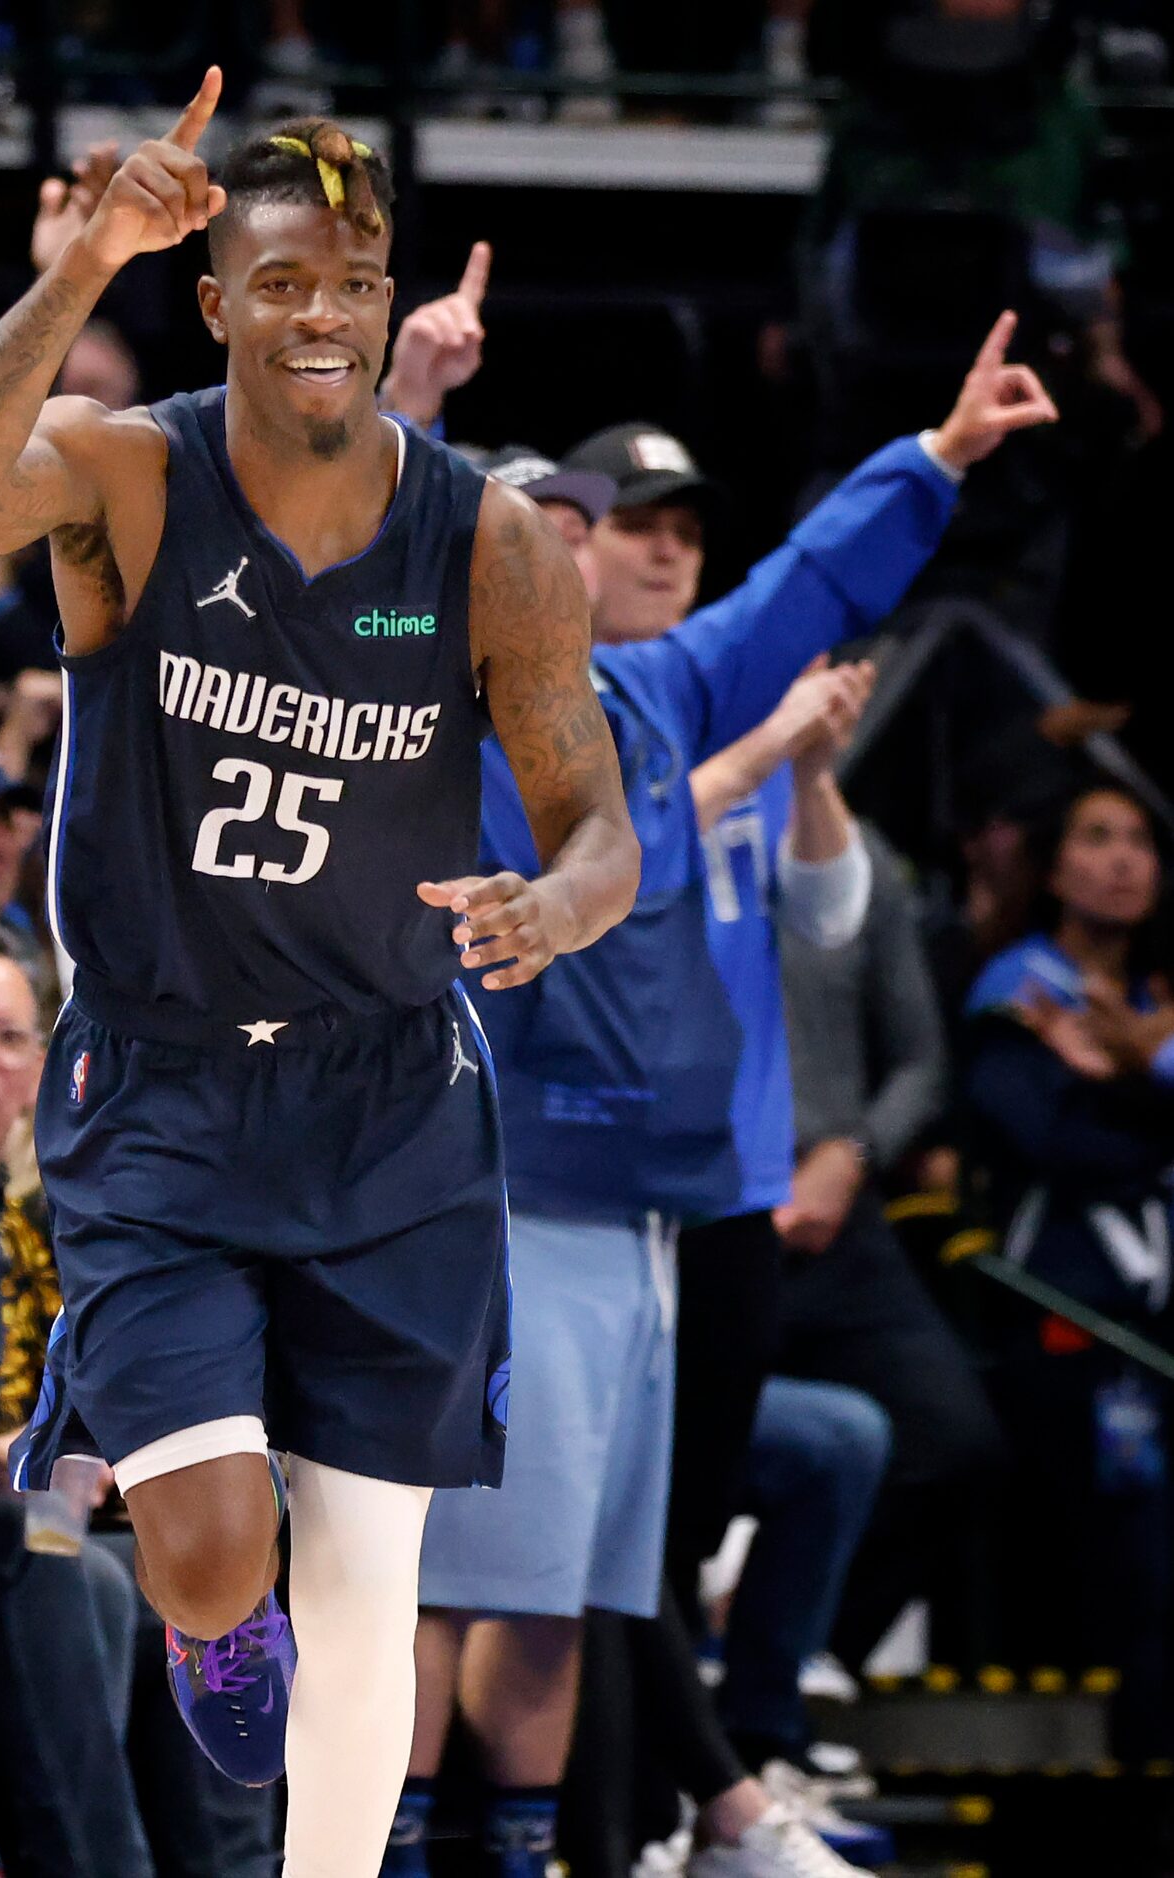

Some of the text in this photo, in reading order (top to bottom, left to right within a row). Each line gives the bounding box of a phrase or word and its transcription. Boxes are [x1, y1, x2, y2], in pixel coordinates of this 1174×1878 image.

[354, 609, 437, 638] chime
[159, 649, 442, 762] MAVERICKS
[191, 757, 345, 885] 25
